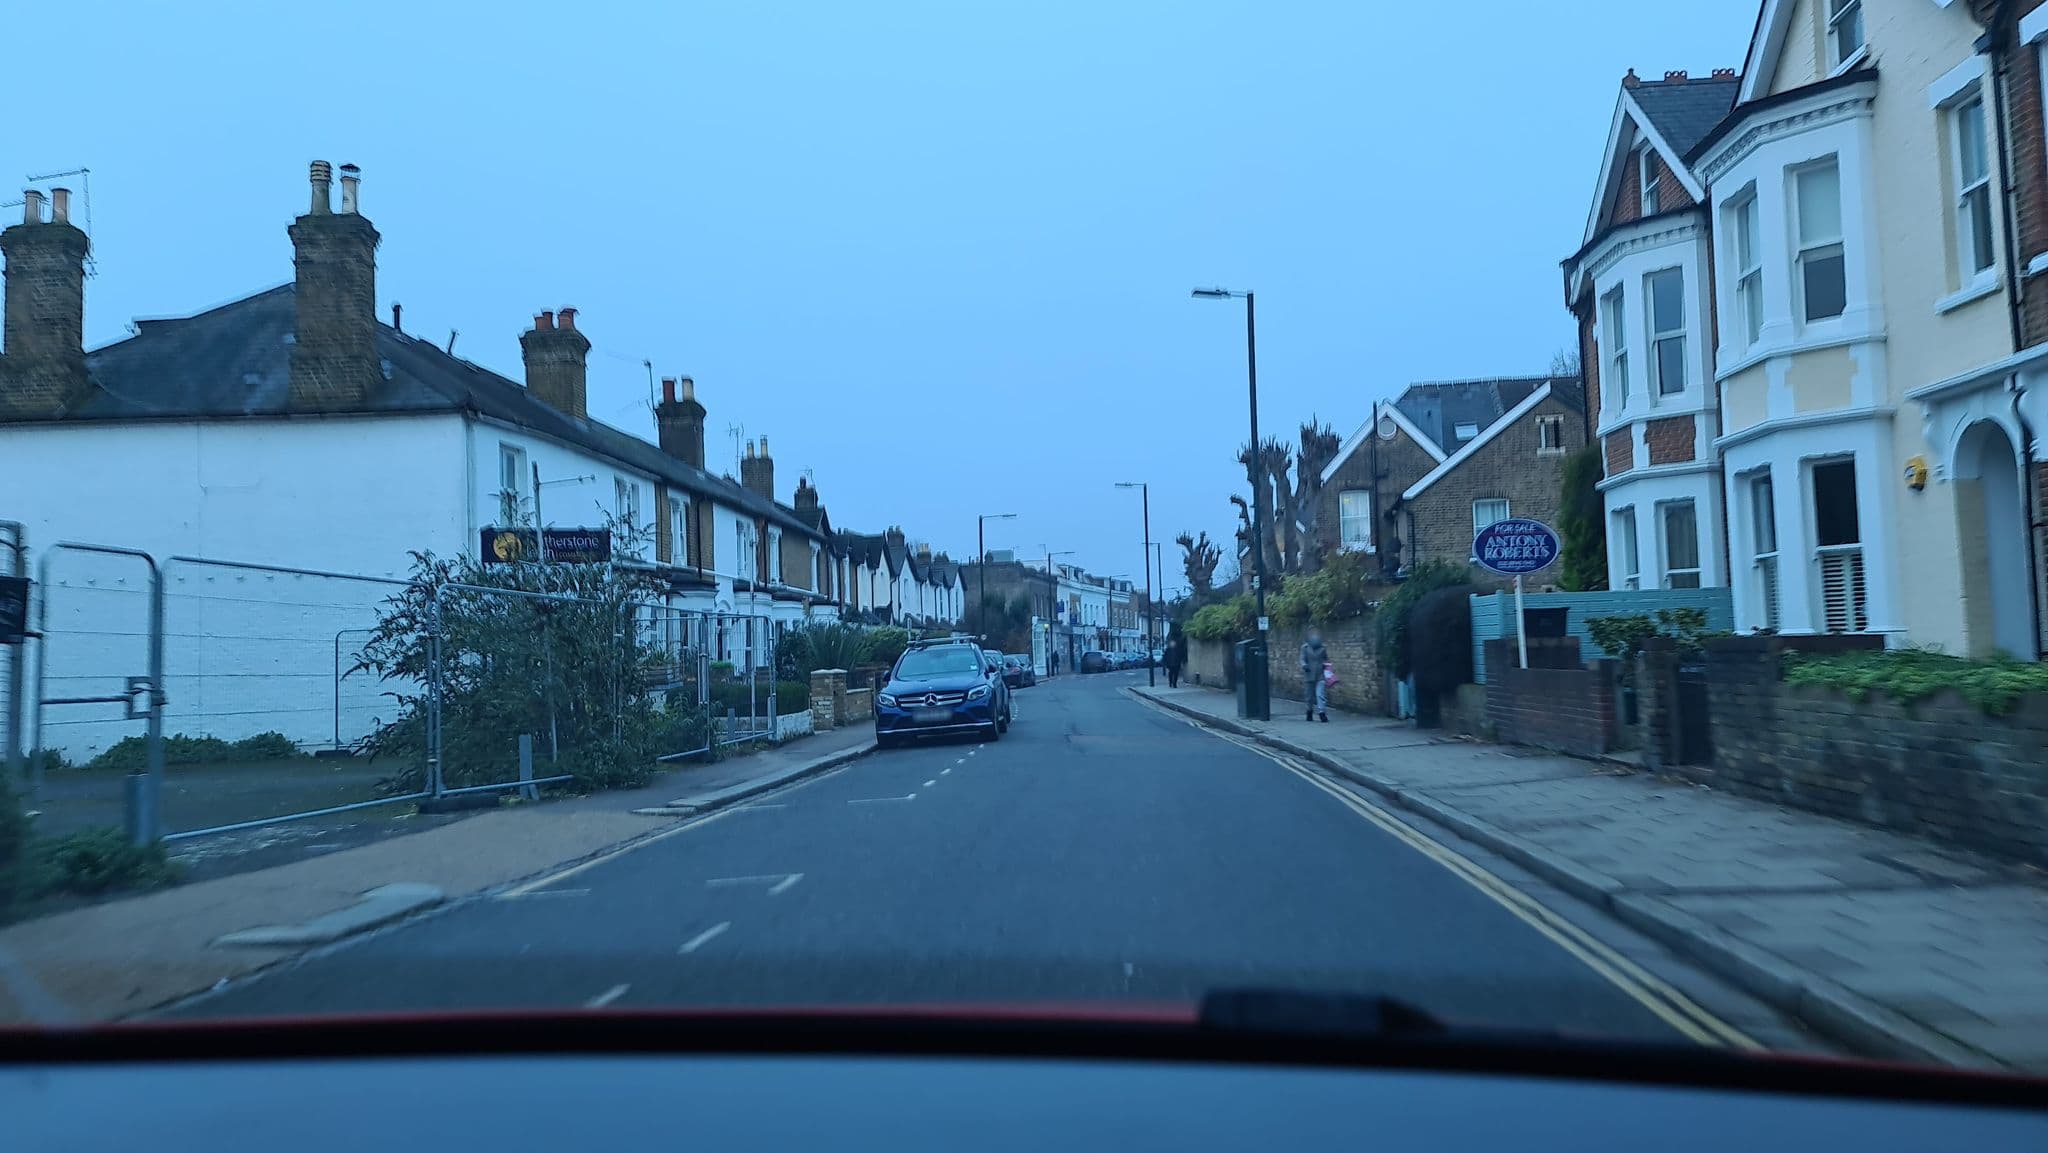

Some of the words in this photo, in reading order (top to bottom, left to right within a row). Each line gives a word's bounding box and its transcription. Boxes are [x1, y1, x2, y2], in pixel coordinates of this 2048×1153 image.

[1495, 524, 1514, 534] FOR
[1486, 535, 1548, 547] ANTONY
[1484, 546, 1550, 560] ROBERTS
